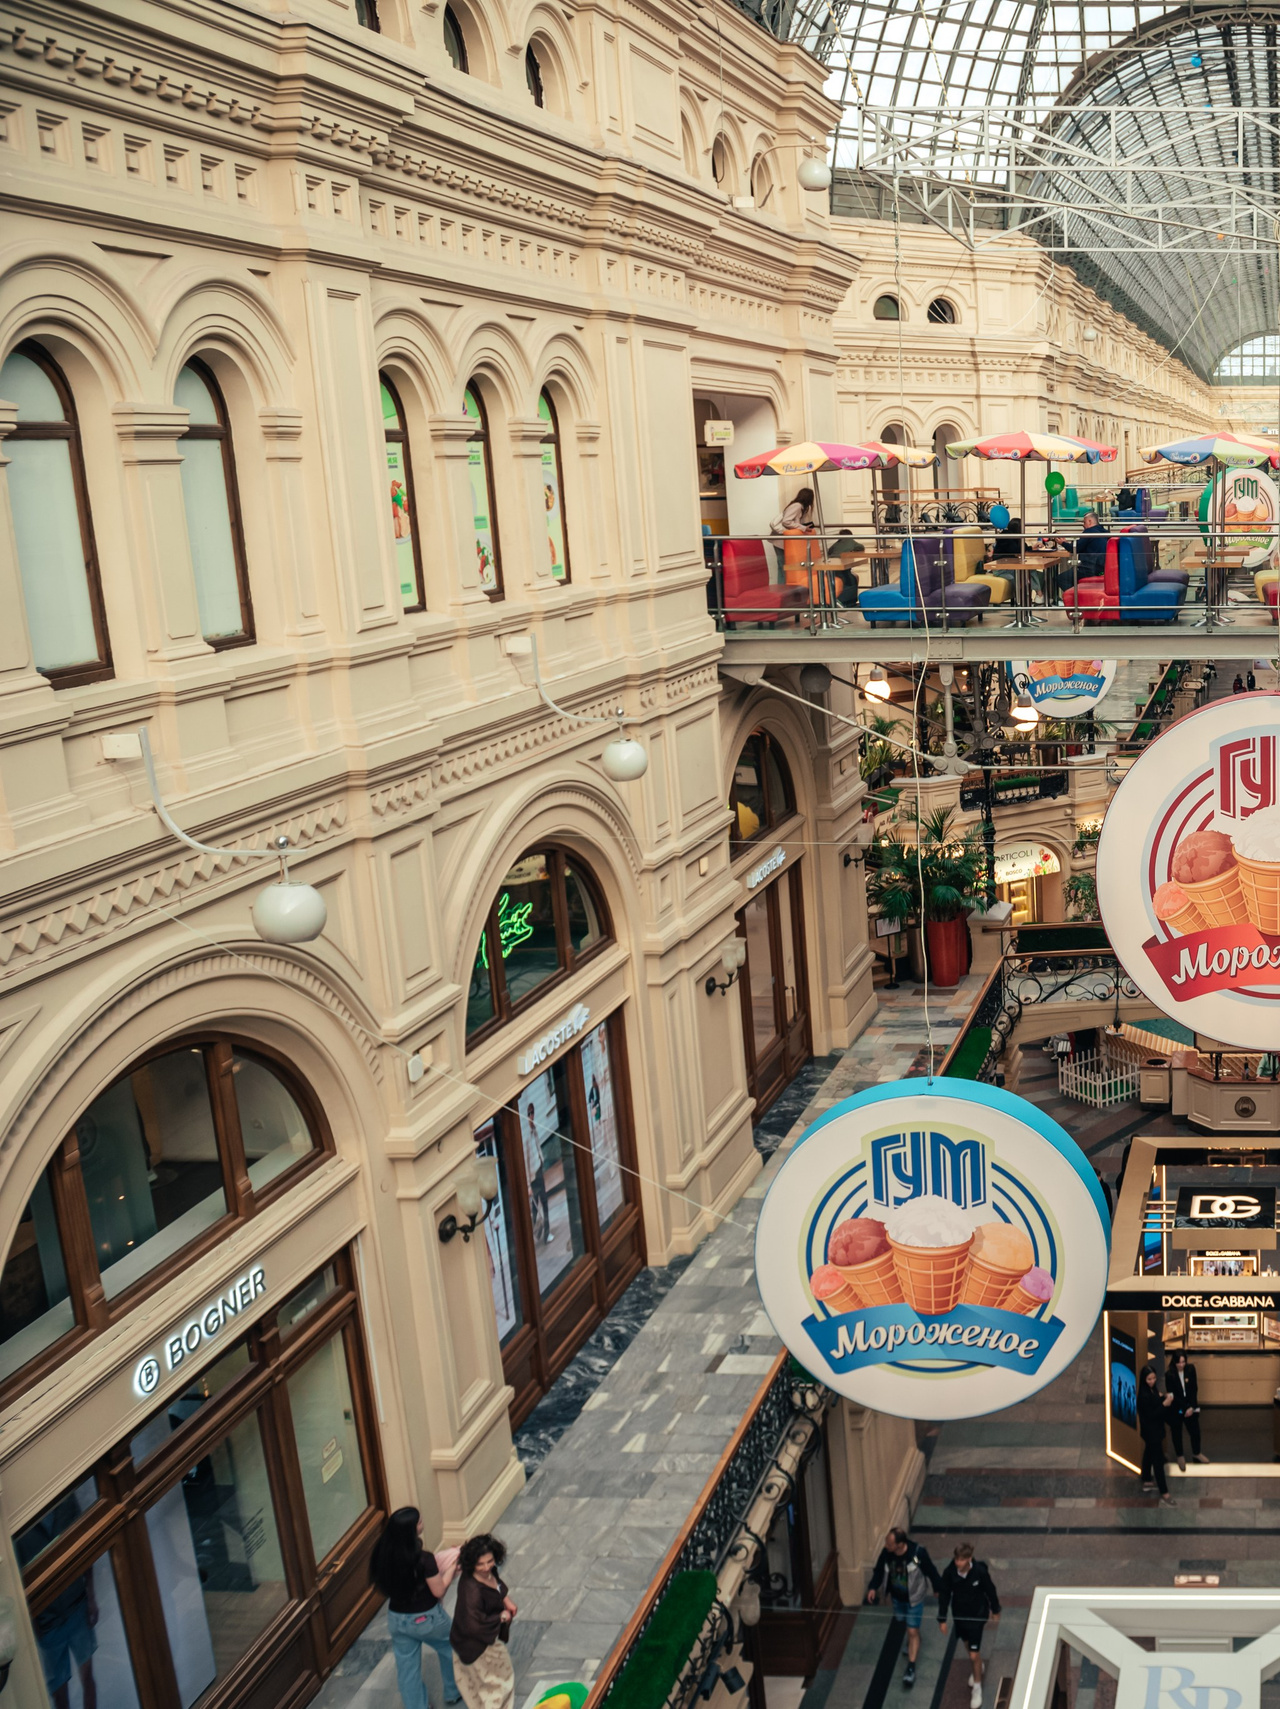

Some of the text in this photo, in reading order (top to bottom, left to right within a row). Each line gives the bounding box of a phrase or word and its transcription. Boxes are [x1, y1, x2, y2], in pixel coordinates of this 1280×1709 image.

[1234, 477, 1258, 500] ГУМ
[1034, 680, 1099, 698] Мороженое
[747, 856, 778, 889] LACOSTE
[517, 1019, 574, 1076] LACOSTE
[871, 1131, 987, 1210] ГУМ
[1190, 1195, 1261, 1218] DG
[167, 1267, 266, 1370] BOGNER
[830, 1320, 1040, 1359] Мороженое
